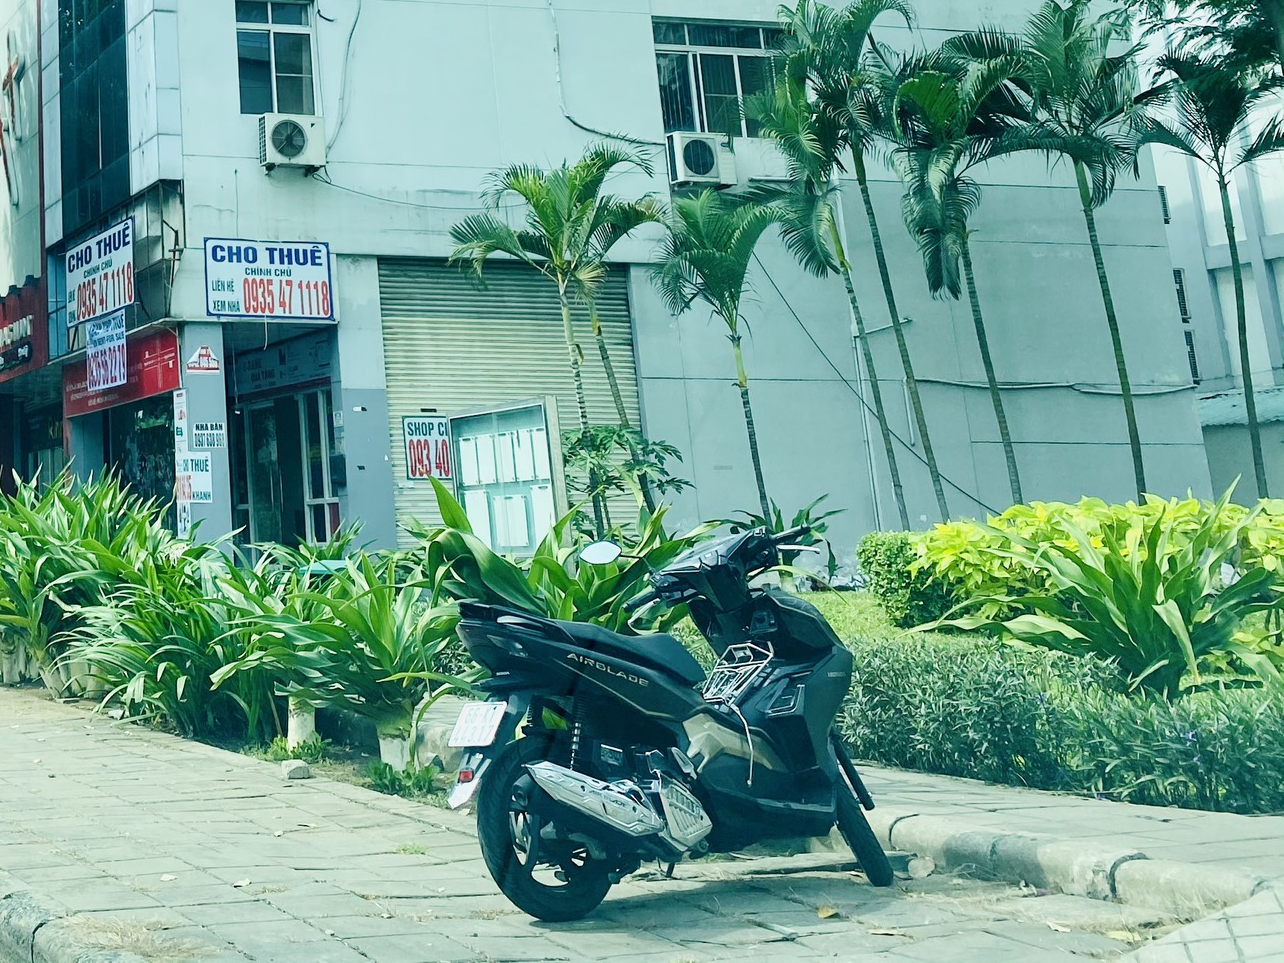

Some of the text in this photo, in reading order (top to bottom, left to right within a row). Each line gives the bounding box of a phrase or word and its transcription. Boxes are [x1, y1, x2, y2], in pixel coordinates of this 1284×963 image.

[68, 222, 130, 273] CHO THUÊ
[211, 245, 323, 266] CHO THUÊ
[245, 266, 292, 277] CHÍNH CHỦ
[77, 278, 96, 321] 0935
[99, 272, 108, 313] 47
[111, 261, 133, 308] 1118
[211, 278, 225, 292] LIÊN
[213, 300, 226, 312] XEM
[243, 278, 329, 316] 0935 47 1118
[408, 422, 434, 436] SHOP
[190, 456, 209, 472] THUÊ
[409, 439, 450, 477] 093 40
